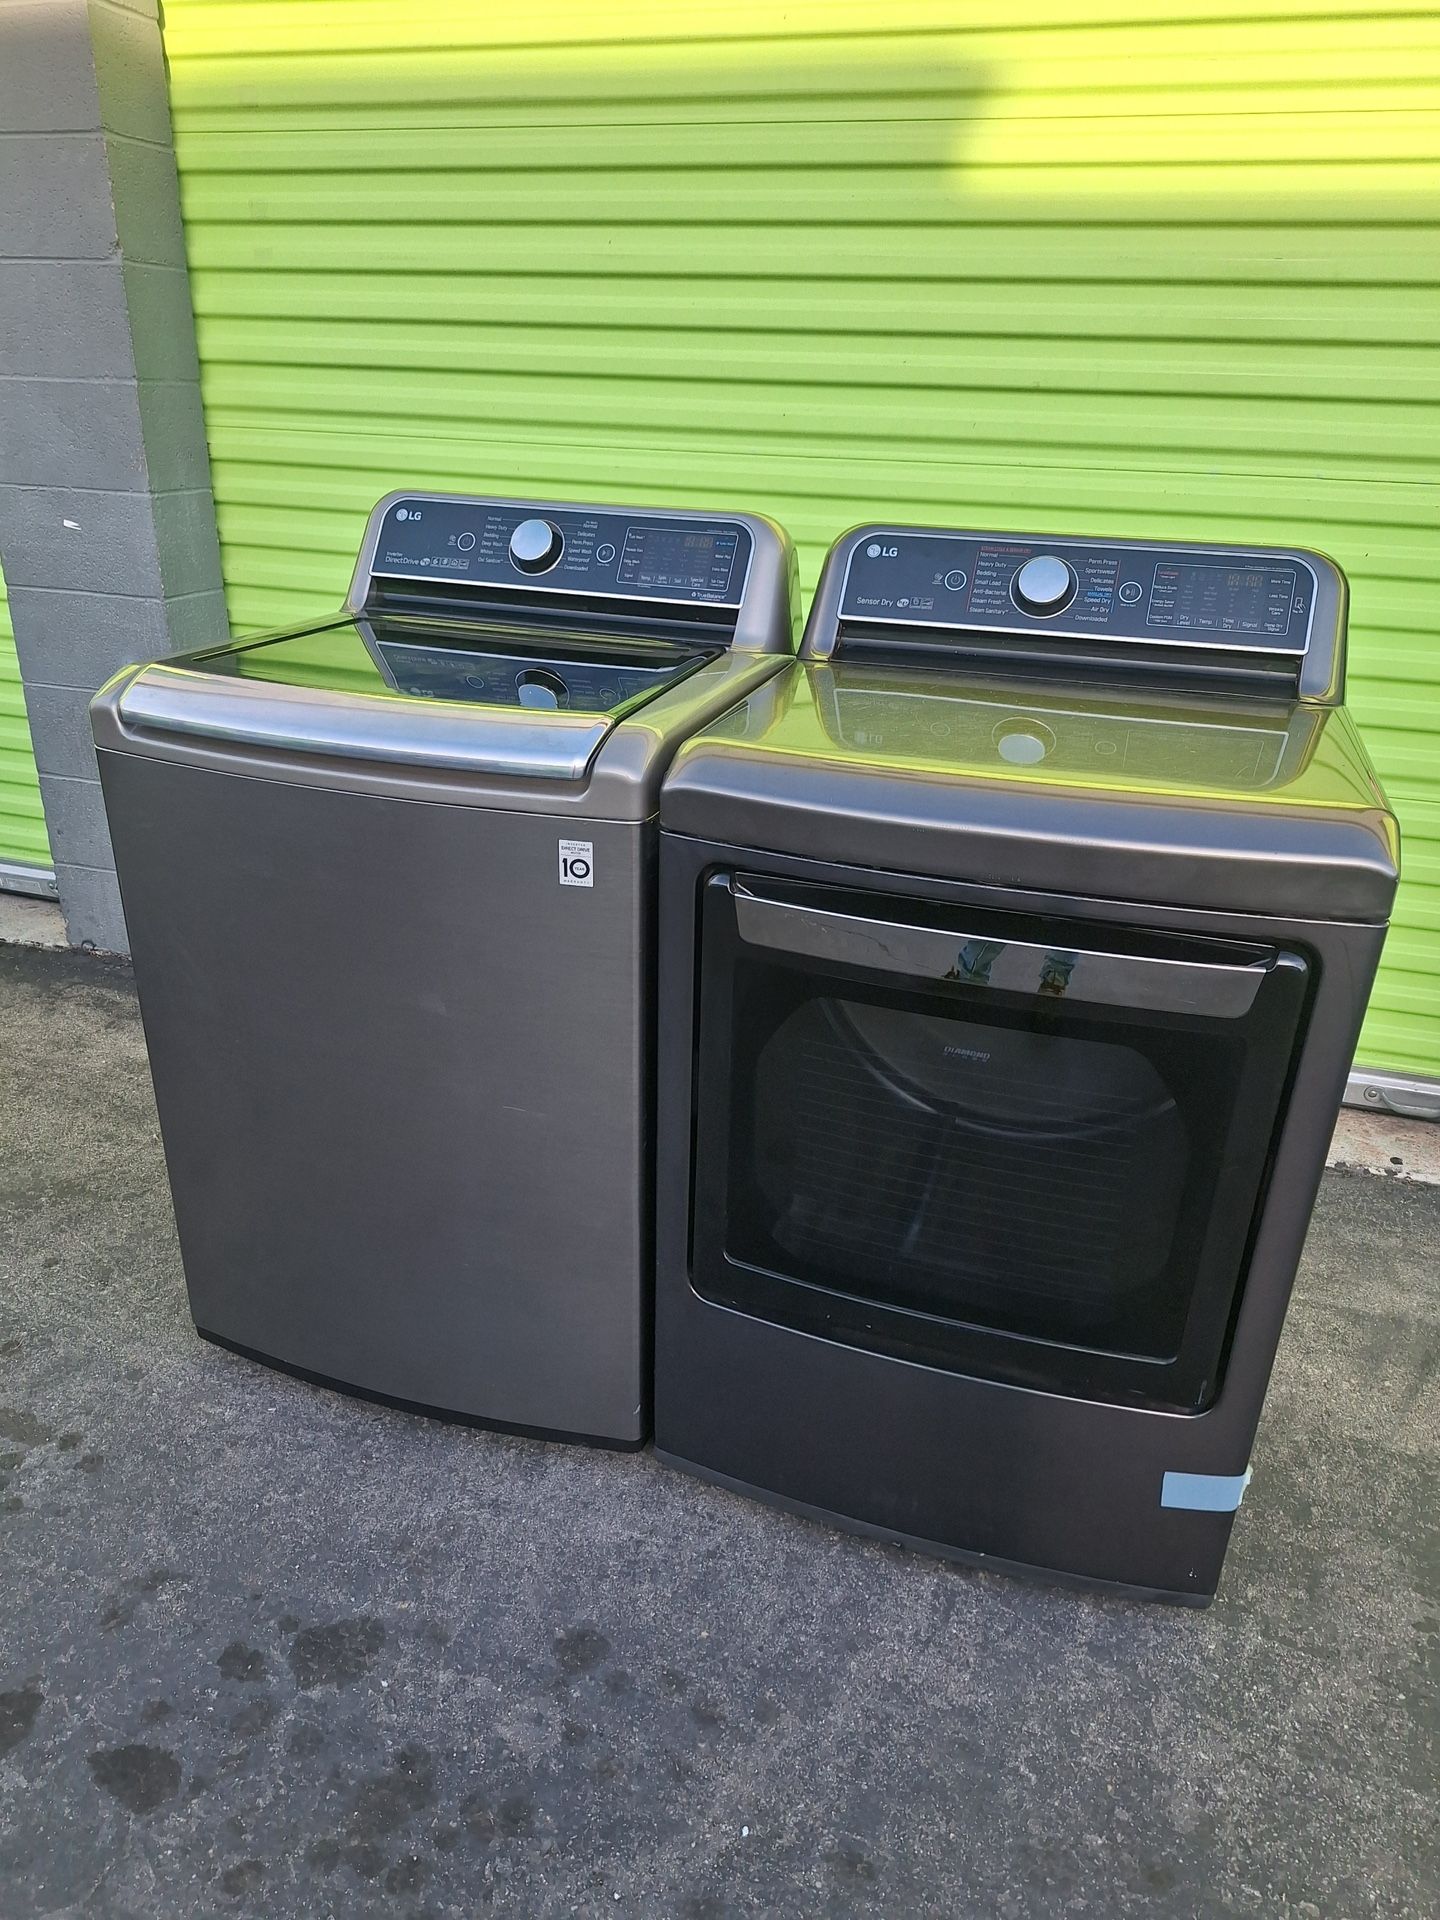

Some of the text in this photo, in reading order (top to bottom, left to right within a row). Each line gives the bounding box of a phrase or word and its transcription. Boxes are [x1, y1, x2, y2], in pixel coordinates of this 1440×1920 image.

[408, 511, 422, 520] LG
[882, 546, 898, 557] LG
[978, 560, 994, 568] Heavy
[856, 596, 894, 607] Sensor Dry
[562, 858, 590, 879] 10
[944, 1046, 990, 1060] DIAMOND
